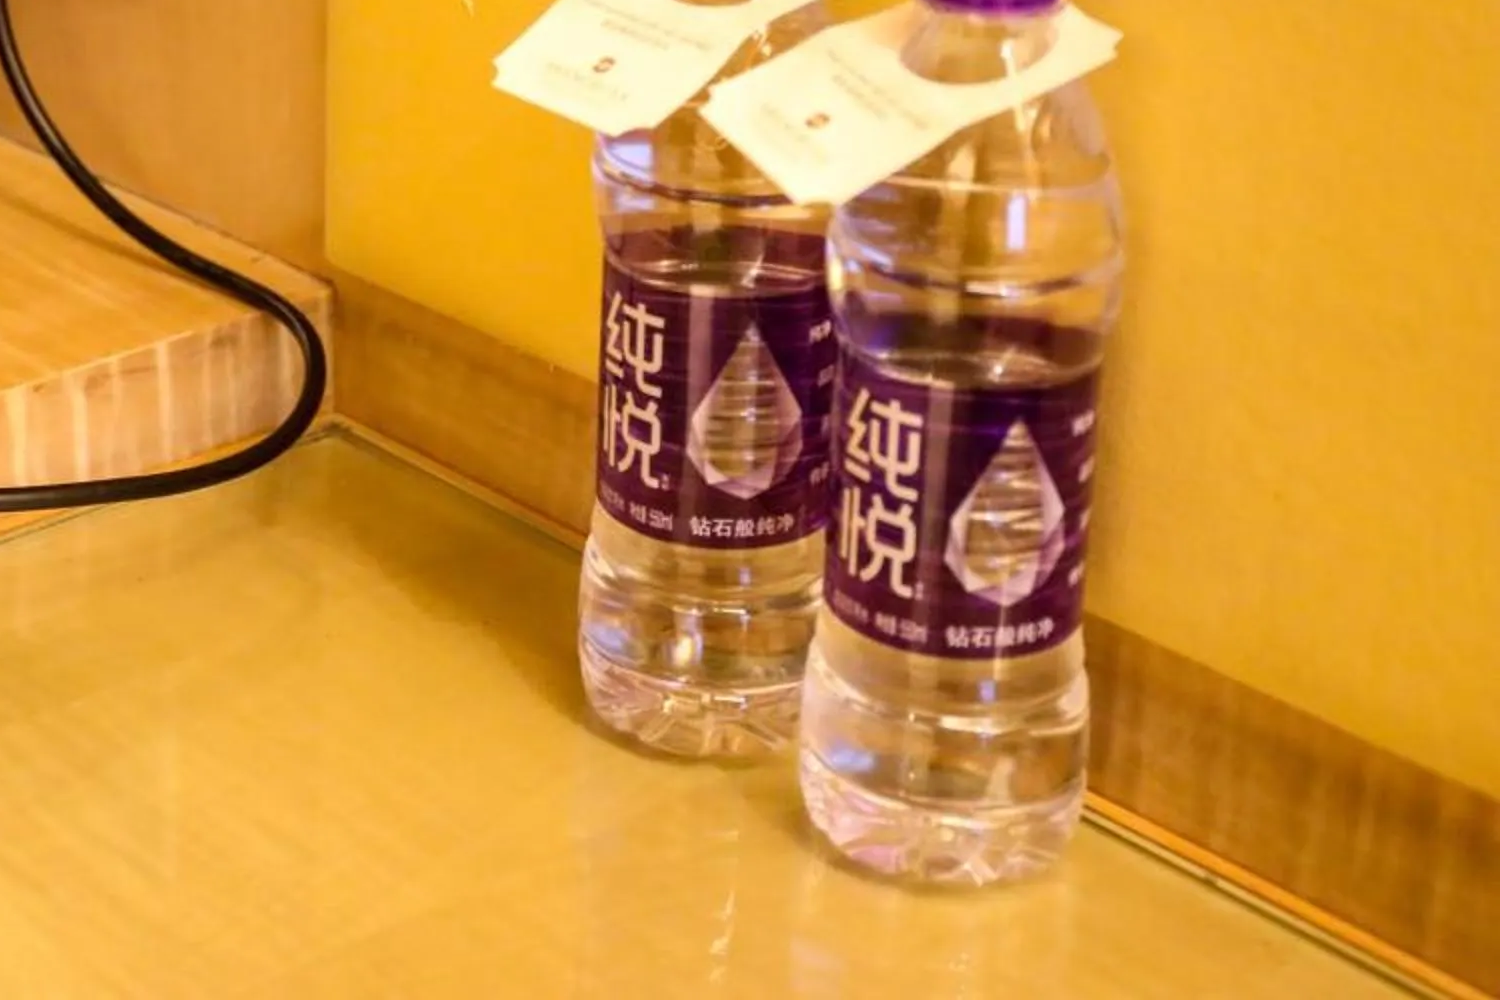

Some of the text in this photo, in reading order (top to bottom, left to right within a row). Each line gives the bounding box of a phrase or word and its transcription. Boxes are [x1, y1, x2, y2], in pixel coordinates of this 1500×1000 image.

[603, 291, 666, 489] 纯悦
[689, 514, 794, 537] 钻石般纯净
[840, 388, 924, 599] 纯悦
